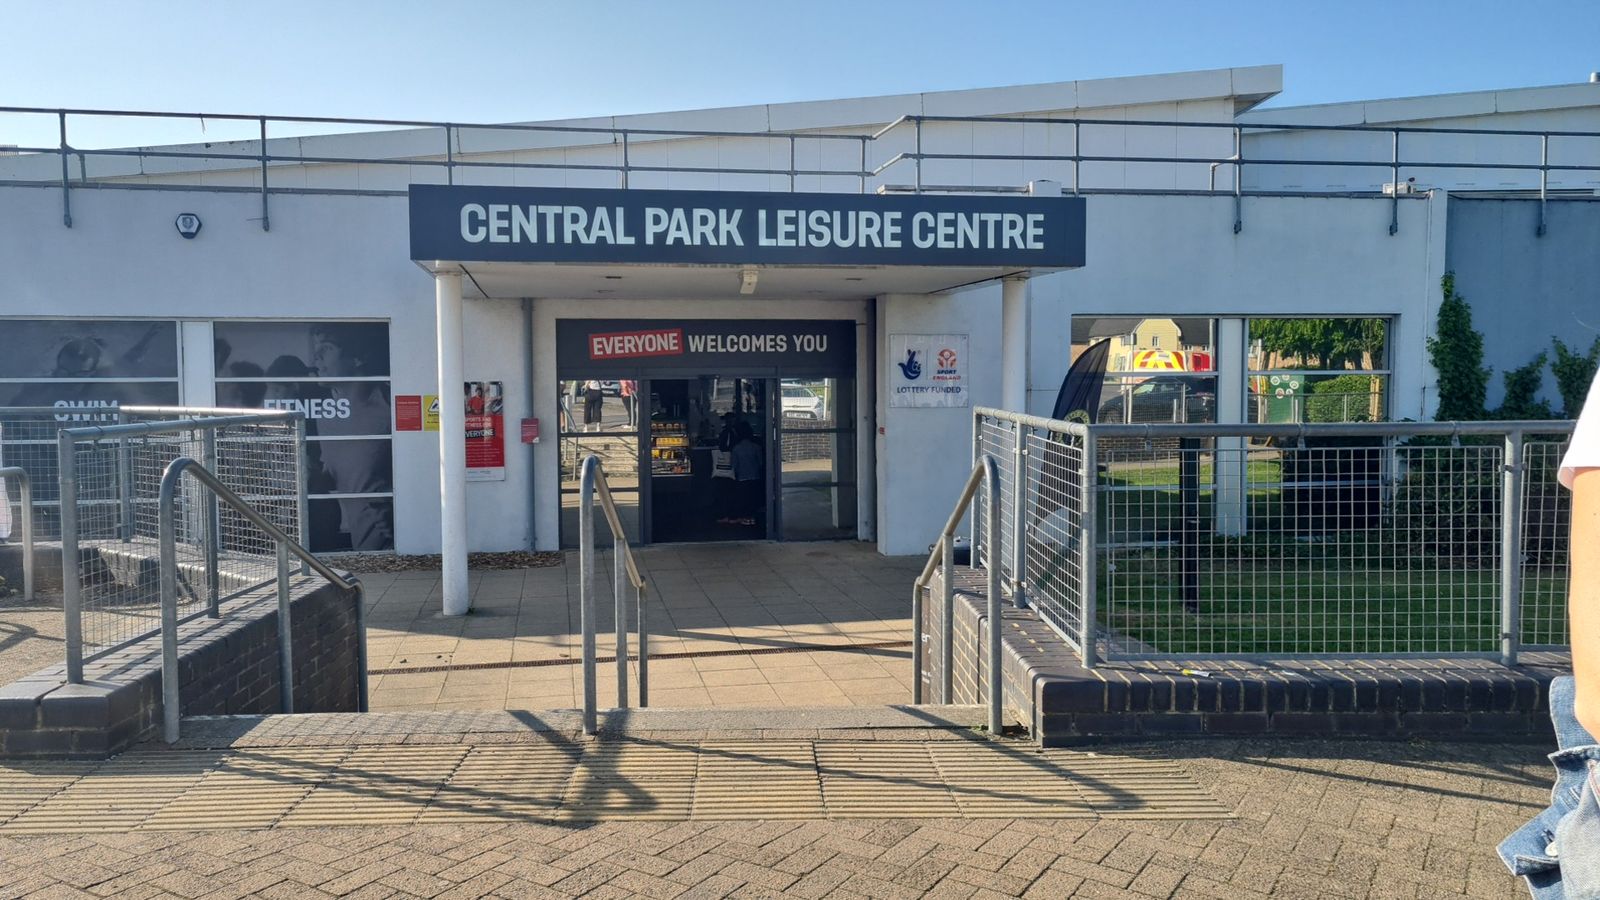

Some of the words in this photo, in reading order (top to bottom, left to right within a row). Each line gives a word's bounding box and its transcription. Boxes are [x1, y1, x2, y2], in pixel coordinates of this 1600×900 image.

[460, 203, 636, 245] CENTRAL
[644, 207, 745, 247] PARK
[758, 209, 902, 248] LEISURE
[912, 211, 1045, 250] CENTRE
[592, 333, 679, 355] EVERYONE
[688, 334, 788, 353] WELCOMES
[793, 334, 828, 353] YOU
[897, 386, 929, 394] LOTTERY
[931, 386, 962, 394] FUNDED
[54, 399, 119, 421] SWIM
[263, 398, 351, 419] FITNESS
[465, 429, 494, 437] VERYONE
